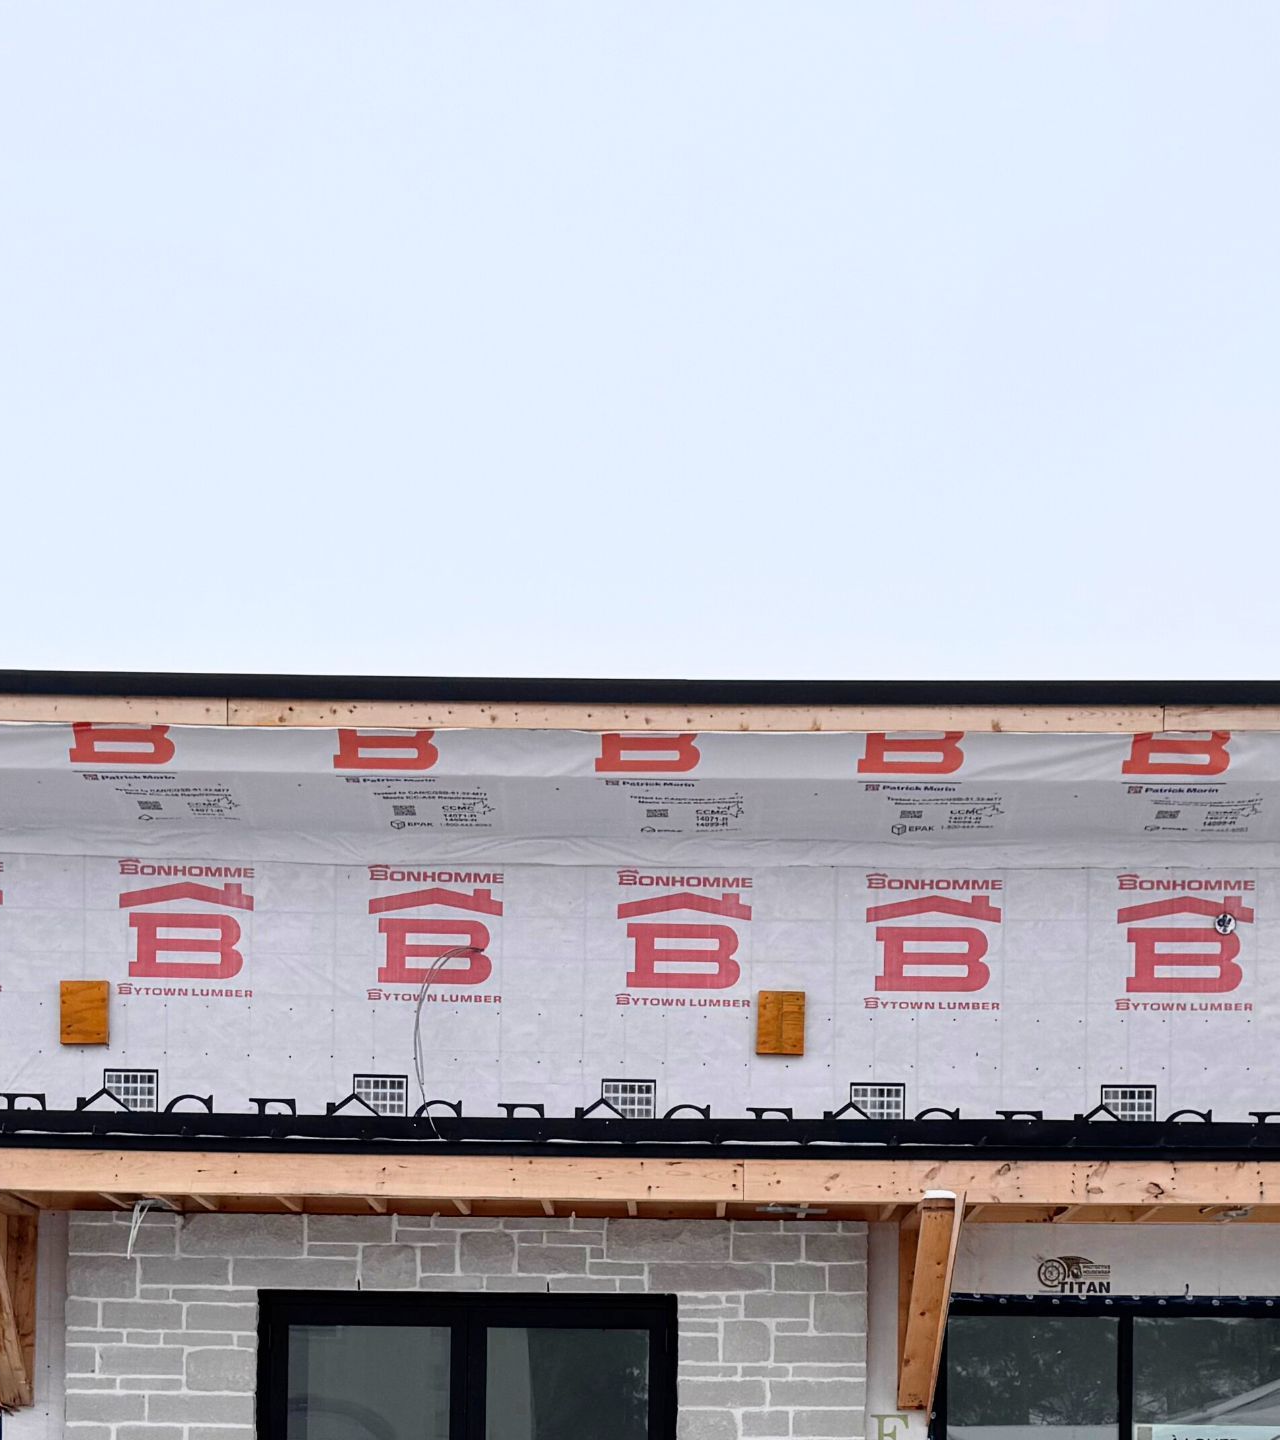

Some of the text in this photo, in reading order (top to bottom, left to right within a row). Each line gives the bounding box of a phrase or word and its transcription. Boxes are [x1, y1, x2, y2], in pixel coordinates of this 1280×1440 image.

[118, 858, 254, 878] BONHOMME
[368, 864, 504, 884] BONHOMME
[617, 869, 753, 888] BONHOMME
[865, 873, 1003, 891] BONHOMME
[1116, 874, 1255, 891] BONHOMME
[129, 912, 244, 979] B
[378, 918, 492, 985] B
[626, 923, 740, 990] B
[875, 926, 990, 992] B
[1125, 927, 1243, 994] B
[116, 982, 253, 998] BYTOWN LUMBER
[367, 988, 502, 1004] BYTOWN LUMBER
[615, 993, 751, 1008] BYTOWN LUMBER
[863, 997, 1001, 1011] BYTOWN LUMBER
[1115, 998, 1253, 1012] BYTOWN LUMBER
[1058, 1281, 1111, 1294] TITAN
